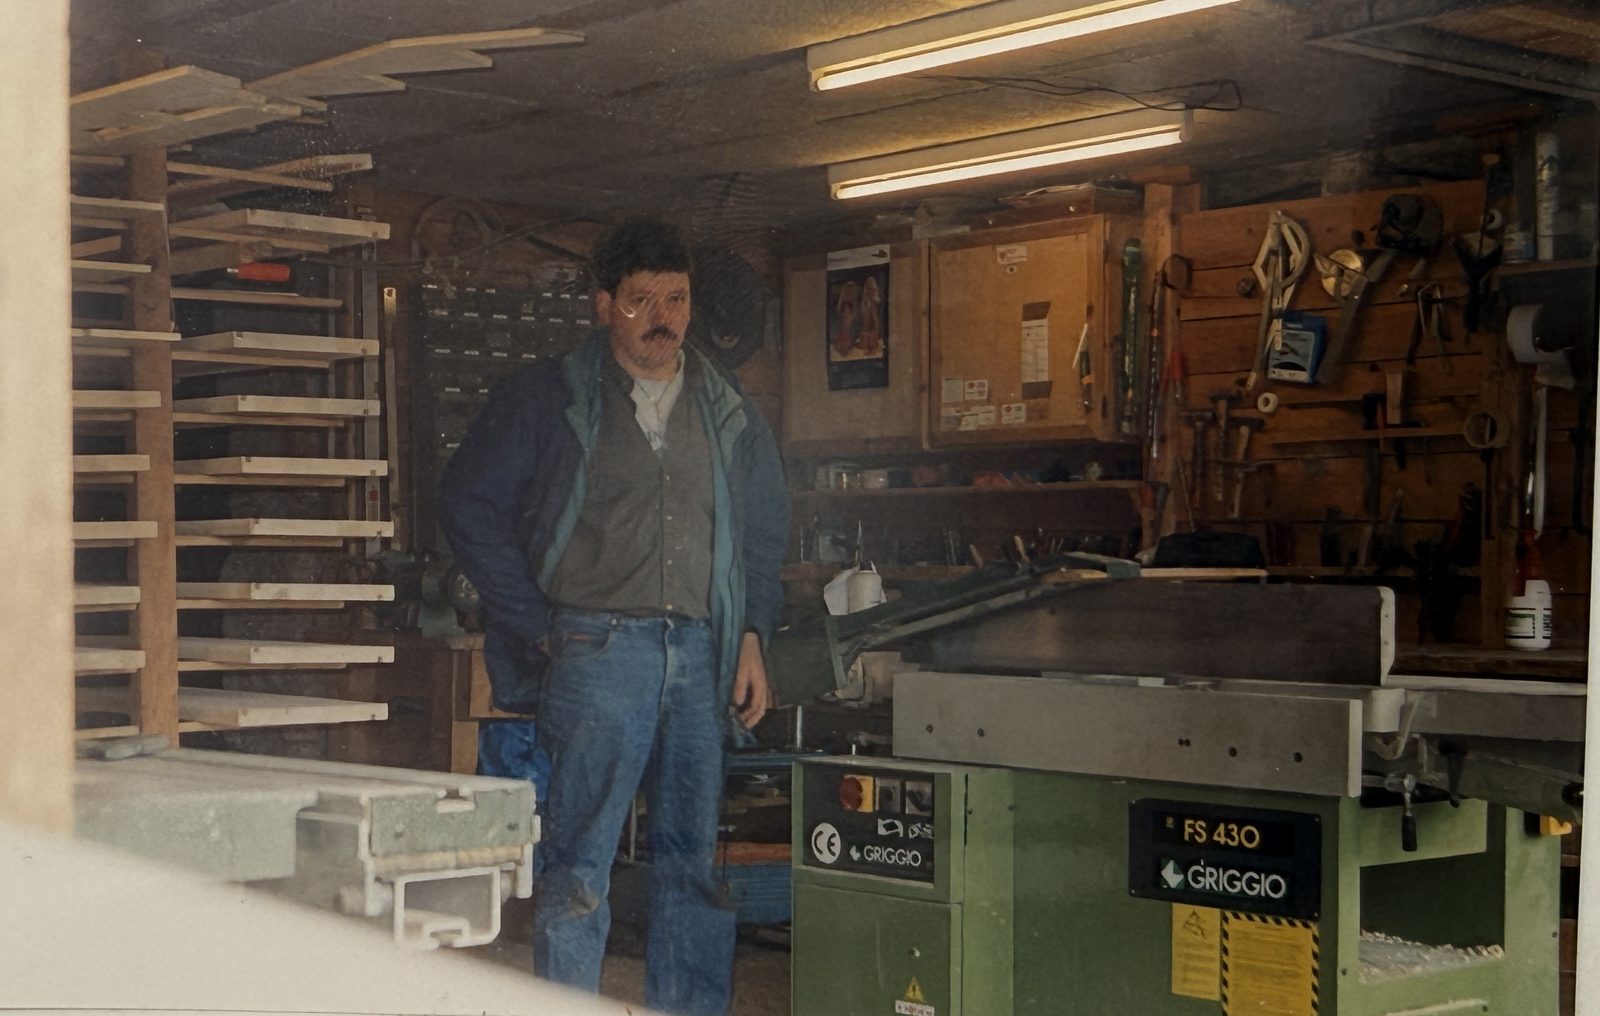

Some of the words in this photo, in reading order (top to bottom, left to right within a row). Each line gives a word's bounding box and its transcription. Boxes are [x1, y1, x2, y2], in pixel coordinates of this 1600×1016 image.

[1183, 819, 1207, 843] FS
[1212, 822, 1260, 849] 430
[863, 845, 922, 867] GRIGGIO
[1187, 864, 1286, 899] GRIGGIO
